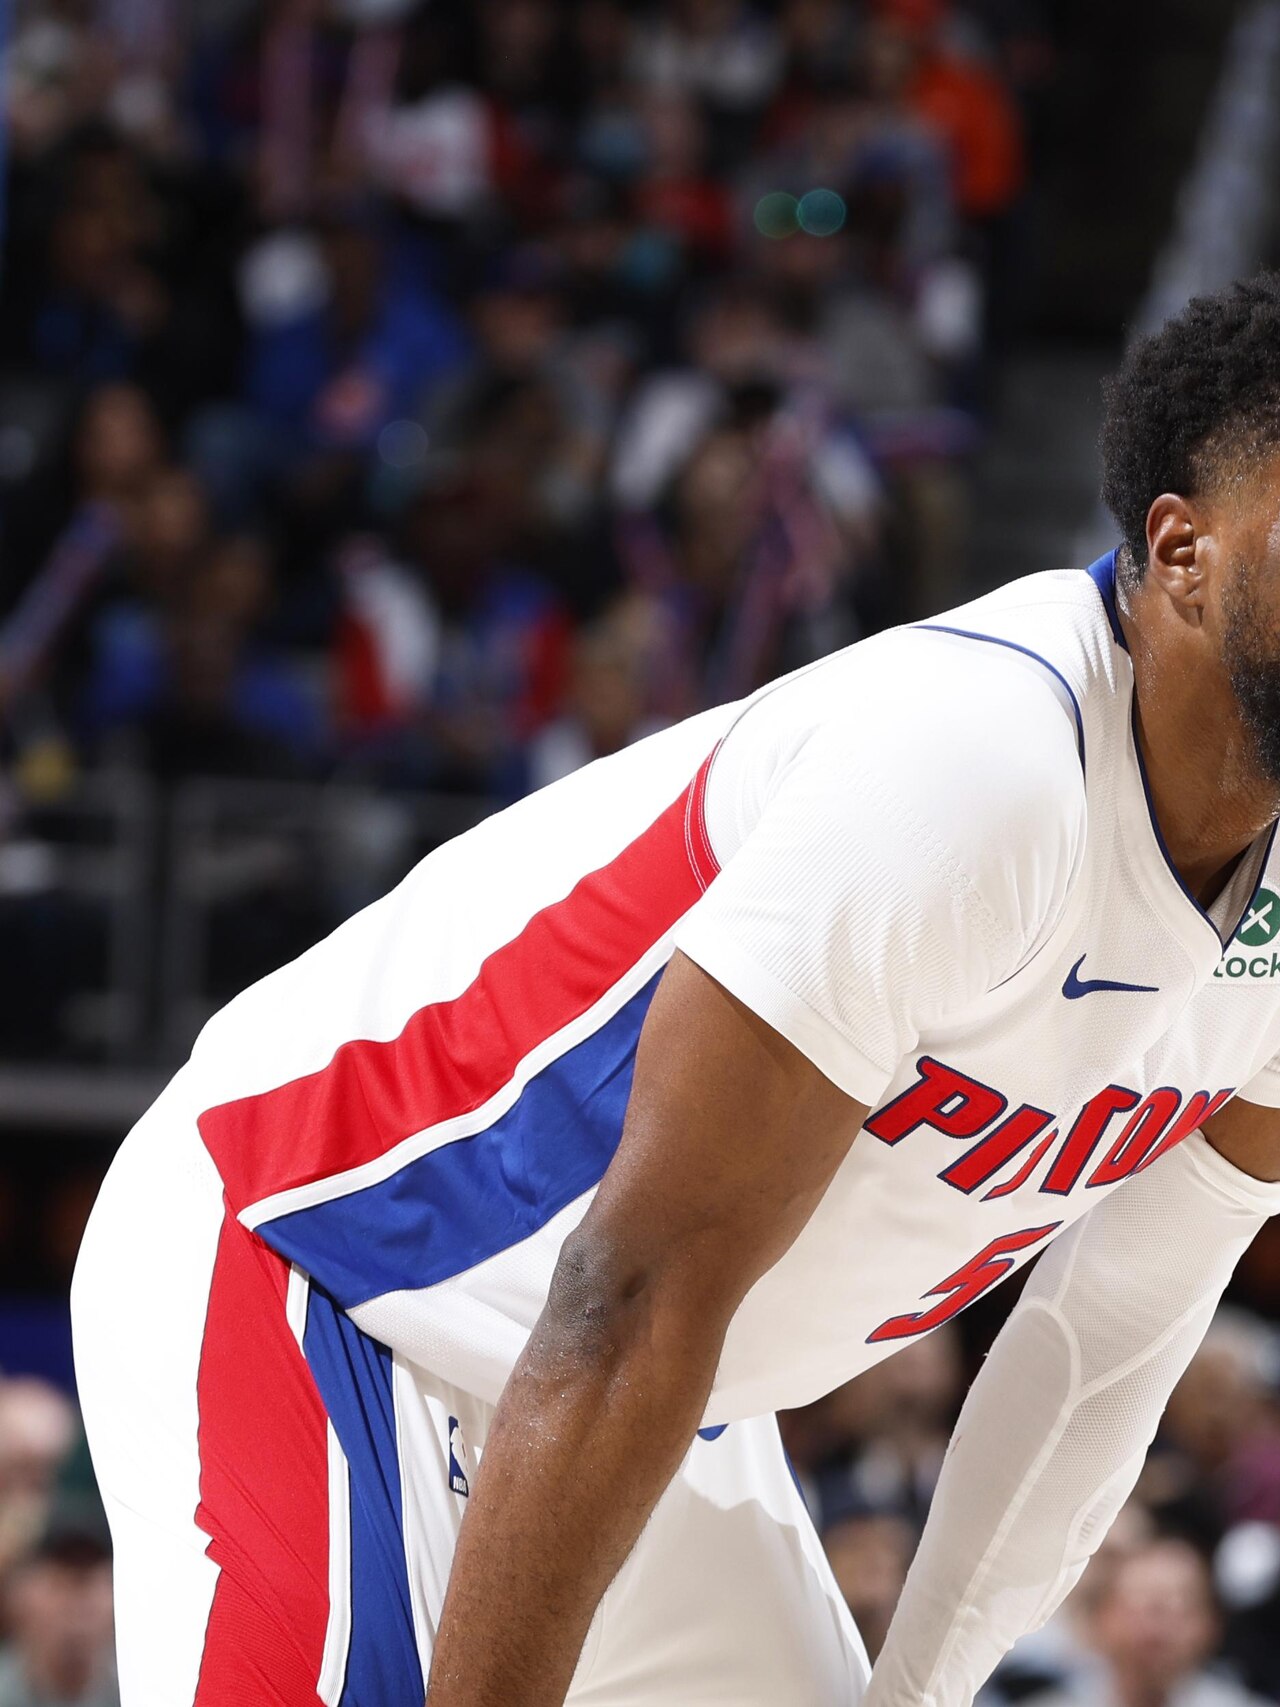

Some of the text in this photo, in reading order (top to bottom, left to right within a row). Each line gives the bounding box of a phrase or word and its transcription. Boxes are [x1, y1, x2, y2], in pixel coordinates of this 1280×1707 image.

[862, 1055, 1237, 1203] PITON
[865, 1220, 1065, 1345] 5
[453, 1475, 468, 1494] NBA
